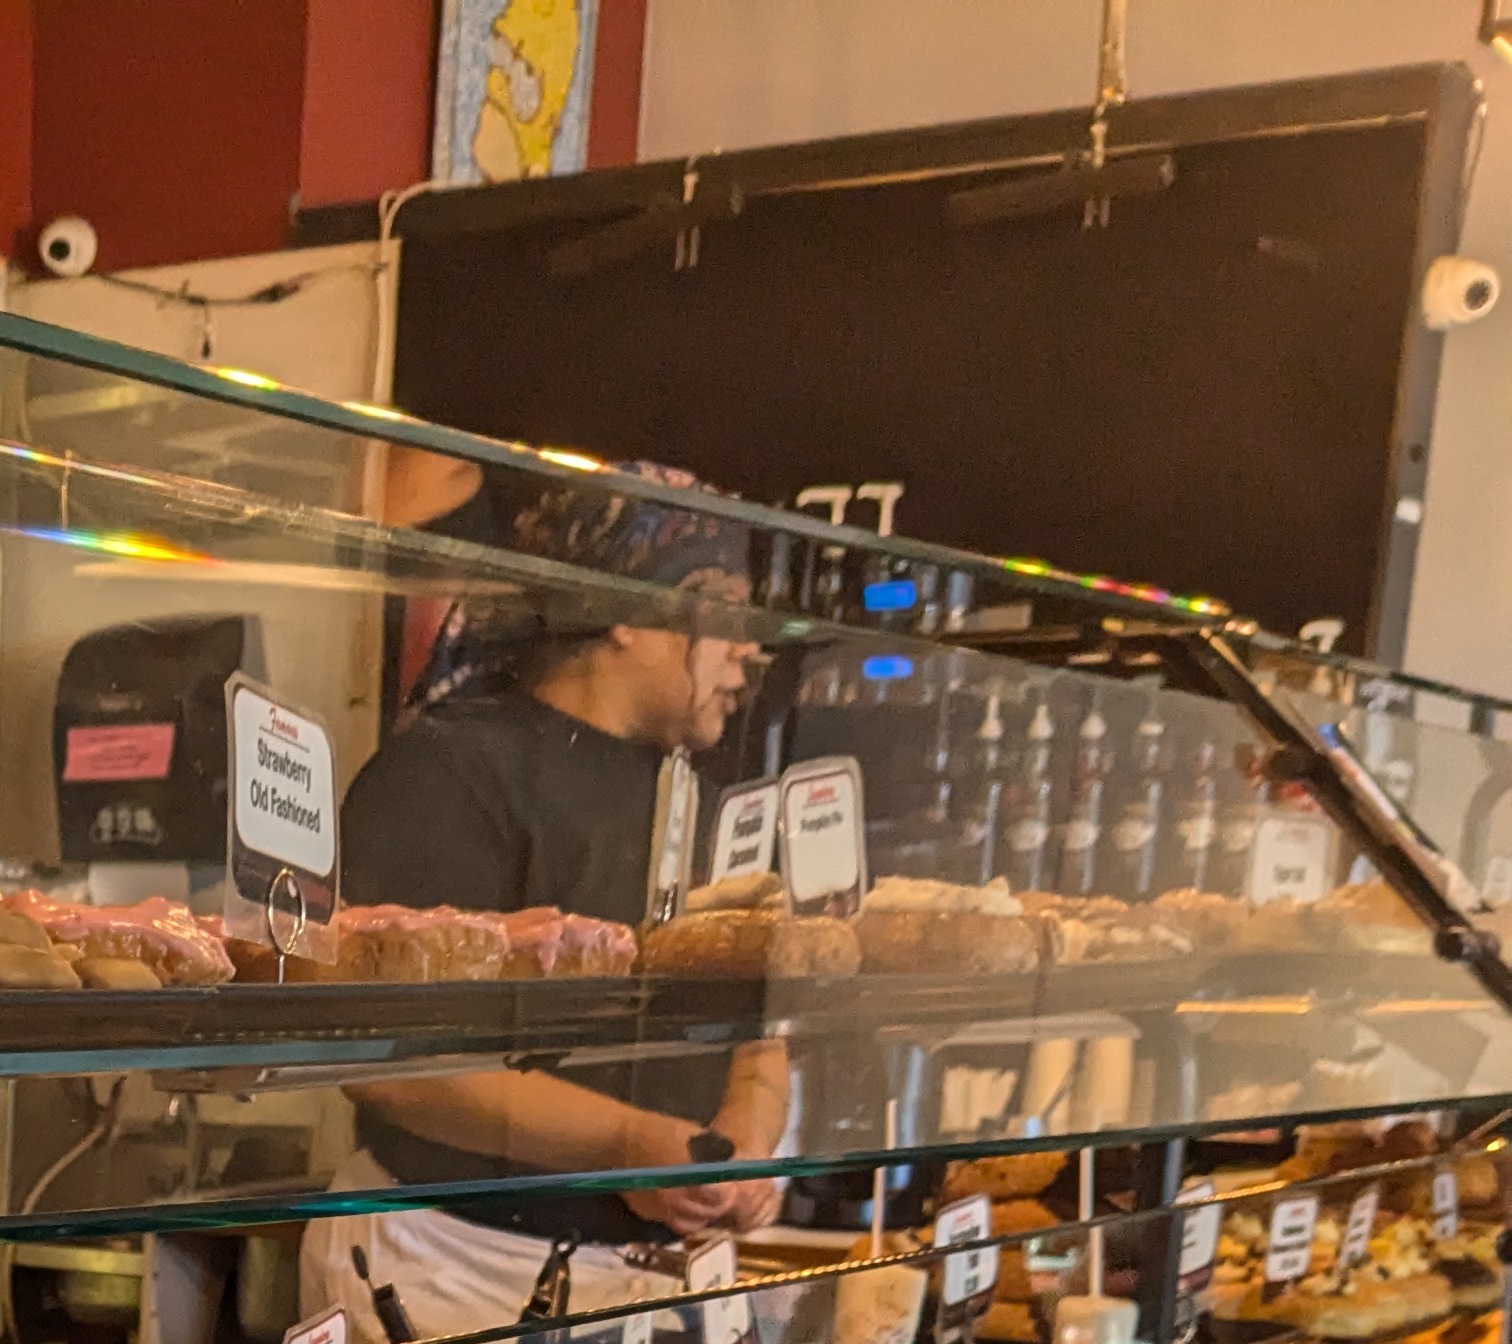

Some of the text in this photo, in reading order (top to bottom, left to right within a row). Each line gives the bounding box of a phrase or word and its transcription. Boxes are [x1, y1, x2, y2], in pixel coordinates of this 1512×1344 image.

[257, 738, 312, 794] Strawberry
[250, 779, 322, 834] Old Fashioned
